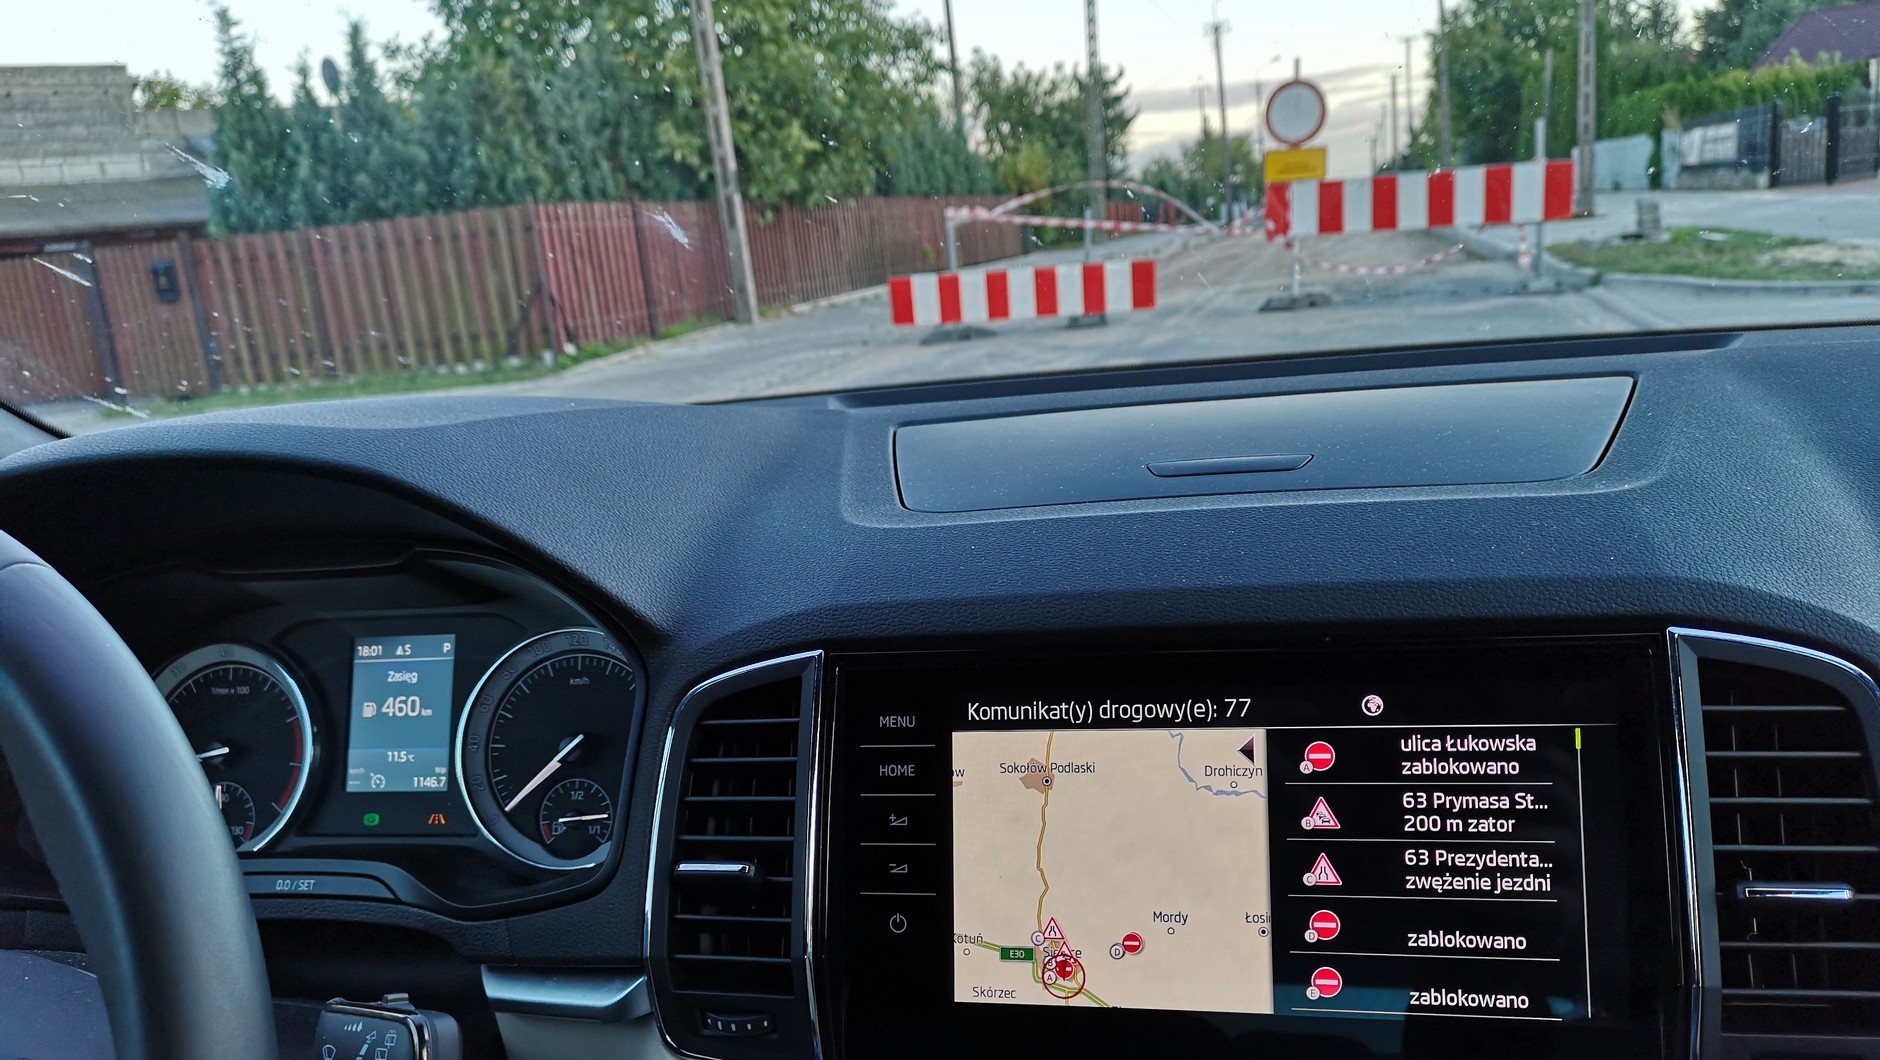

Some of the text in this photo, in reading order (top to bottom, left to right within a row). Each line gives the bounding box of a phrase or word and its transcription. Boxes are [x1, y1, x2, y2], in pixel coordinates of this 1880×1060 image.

[566, 634, 589, 646] 120
[357, 645, 382, 657] 18:01
[528, 640, 550, 657] 100
[387, 670, 418, 684] Zasięg
[569, 676, 590, 686] km/h
[236, 686, 250, 695] 100
[381, 695, 433, 717] 460 km
[479, 695, 493, 713] 60
[968, 698, 1251, 724] Komunikat(y) drogowy(e): 77
[879, 715, 916, 728] MENU
[468, 734, 480, 752] 40
[1400, 733, 1537, 752] ulica Łukowska
[434, 766, 447, 775] trip
[879, 764, 916, 777] HOME
[999, 761, 1096, 775] Sokołów Podlaski
[1204, 764, 1263, 779] Drohiczyn
[1401, 757, 1520, 775] zablokowano
[413, 776, 447, 788] 1146.7
[473, 775, 485, 791] 20
[570, 790, 584, 800] 1/2
[1402, 792, 1549, 812] 63 Prymasa St...
[1403, 815, 1516, 833] 200 m zator
[1404, 849, 1553, 871] 63 Prezydenta...
[275, 879, 291, 891] 0.0
[297, 879, 316, 891] SET
[1405, 872, 1551, 895] zwężenie jezdni
[1153, 911, 1189, 926] Mordy
[1245, 911, 1271, 924] Łosi
[1407, 929, 1527, 950] zablokowano
[1009, 949, 1025, 959] E30
[972, 986, 1017, 999] Skórzec
[1409, 987, 1530, 1009] zablokowano
